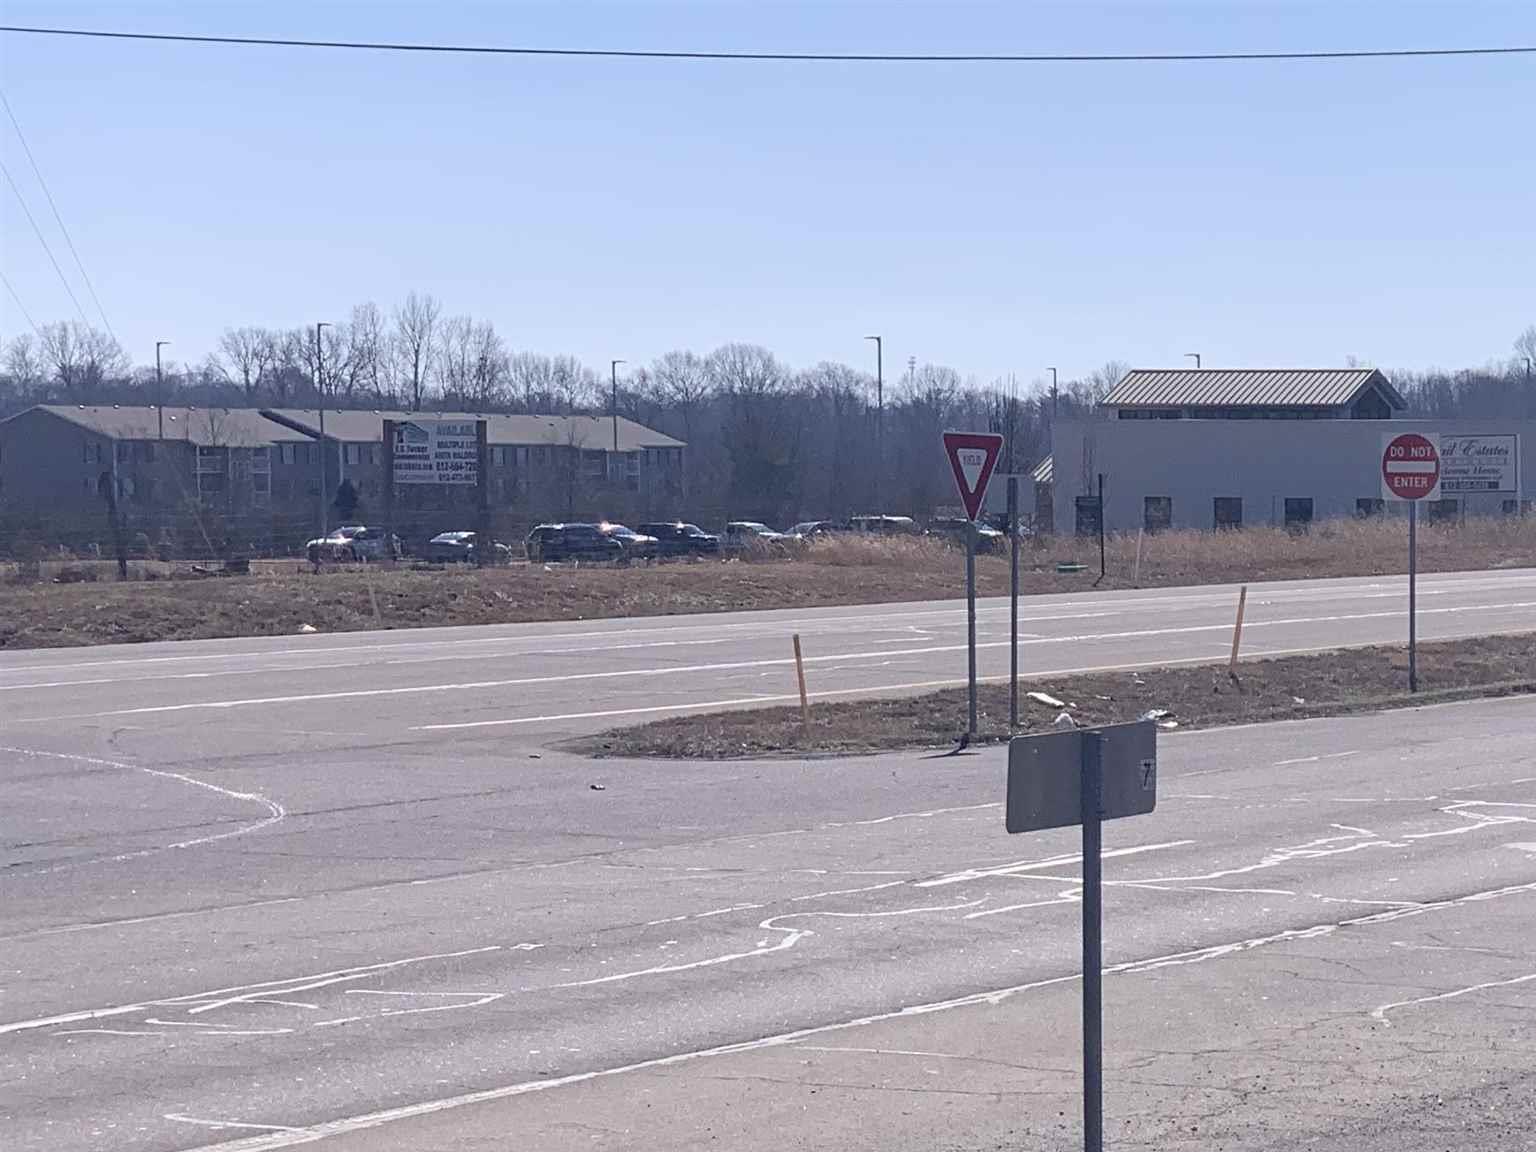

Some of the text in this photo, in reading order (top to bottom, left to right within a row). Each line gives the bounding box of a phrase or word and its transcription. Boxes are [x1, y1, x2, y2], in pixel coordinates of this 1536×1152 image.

[1390, 446, 1431, 457] DO NOT
[1461, 439, 1509, 456] Estates
[963, 455, 982, 465] YIELD
[1394, 477, 1429, 488] ENTER
